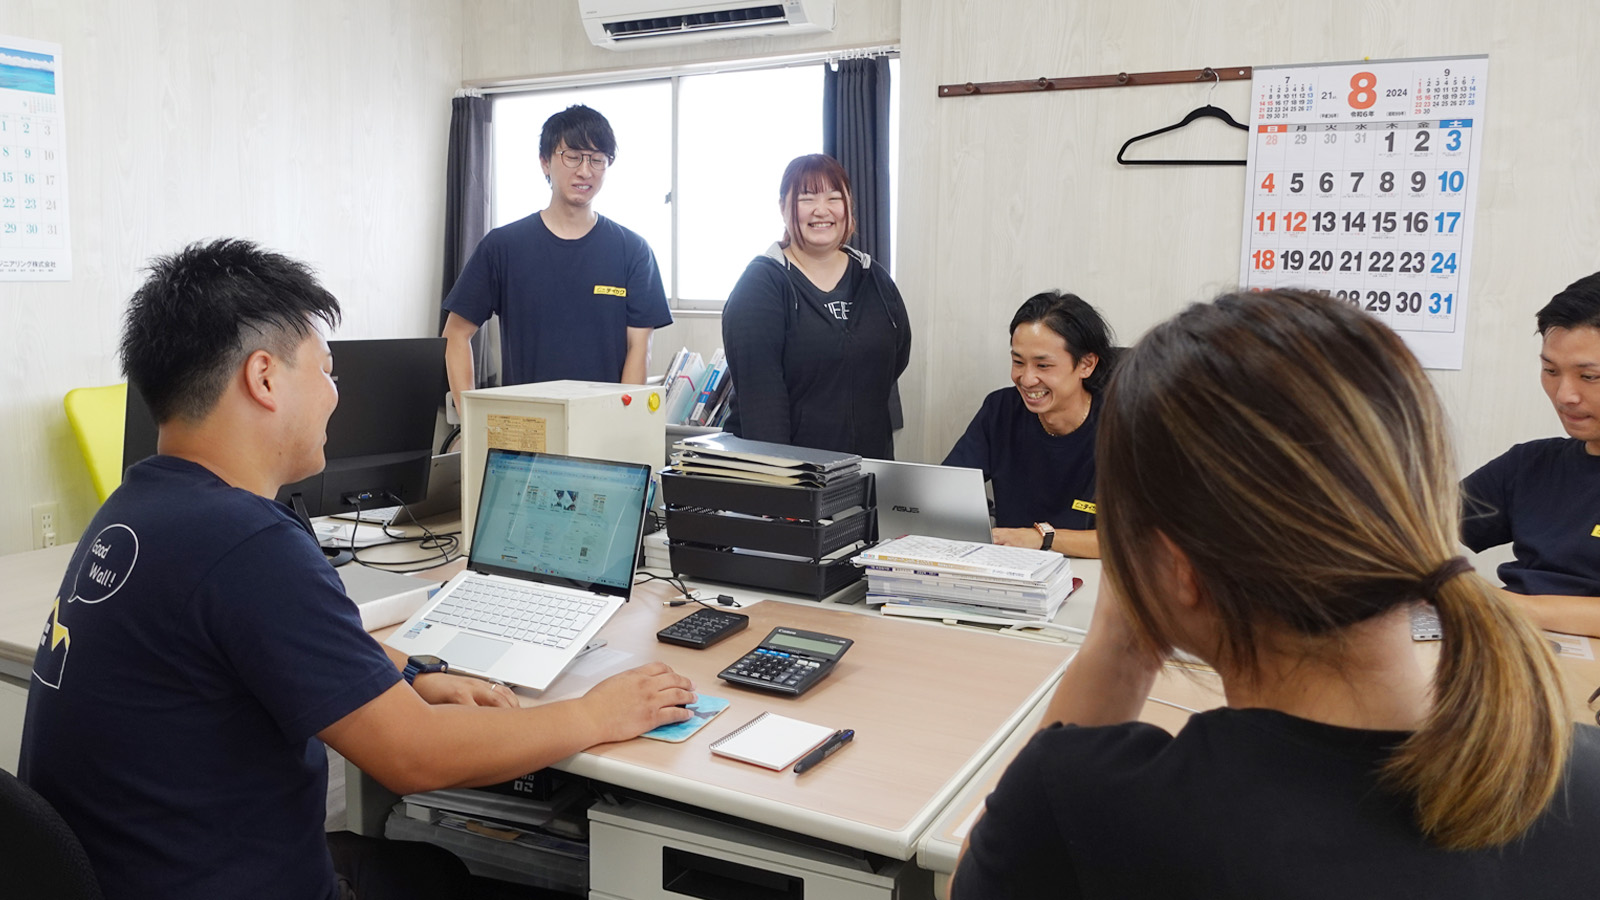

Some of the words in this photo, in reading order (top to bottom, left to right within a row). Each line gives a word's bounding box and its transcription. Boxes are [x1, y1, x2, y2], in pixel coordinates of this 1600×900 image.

[1444, 68, 1450, 76] 9
[1348, 72, 1377, 109] 8
[1386, 88, 1407, 97] 2024
[2, 121, 6, 131] 1
[23, 122, 29, 133] 2
[44, 125, 50, 136] 3
[1265, 135, 1278, 146] 28
[1294, 135, 1307, 145] 29
[1323, 134, 1337, 144] 30
[1354, 133, 1366, 143] 31
[1385, 132, 1395, 153] 1
[1414, 130, 1430, 152] 2
[1446, 130, 1461, 151] 3
[3, 146, 9, 157] 8
[25, 148, 31, 158] 9
[45, 150, 54, 160] 10
[3, 172, 13, 182] 15
[24, 174, 35, 184] 16
[46, 175, 54, 185] 17
[1261, 174, 1275, 193] 4
[1290, 173, 1304, 193] 5
[1319, 172, 1334, 192] 6
[1350, 172, 1365, 192] 7
[1379, 171, 1395, 192] 8
[1411, 171, 1426, 192] 9
[1439, 171, 1464, 192] 10
[3, 197, 15, 208] 22
[24, 199, 36, 209] 23
[4, 223, 16, 233] 29
[26, 224, 37, 234] 30
[48, 224, 57, 234] 31
[1256, 212, 1276, 232] 11
[1283, 212, 1307, 232] 12
[1312, 212, 1336, 233] 13
[1342, 212, 1365, 233] 14
[1372, 212, 1397, 233] 15
[1403, 212, 1428, 233] 16
[1435, 212, 1461, 233] 17
[1253, 250, 1274, 269] 18
[1280, 250, 1304, 270] 19
[1308, 251, 1333, 271] 20
[1340, 251, 1362, 272] 21
[1368, 251, 1394, 272] 22
[1400, 252, 1425, 273] 23
[1430, 252, 1456, 274] 24
[1365, 291, 1391, 312] 29
[1396, 292, 1422, 313] 30
[1428, 292, 1453, 314] 31
[892, 505, 919, 513] ASUS
[92, 539, 111, 559] Good
[89, 562, 116, 587] Wall!
